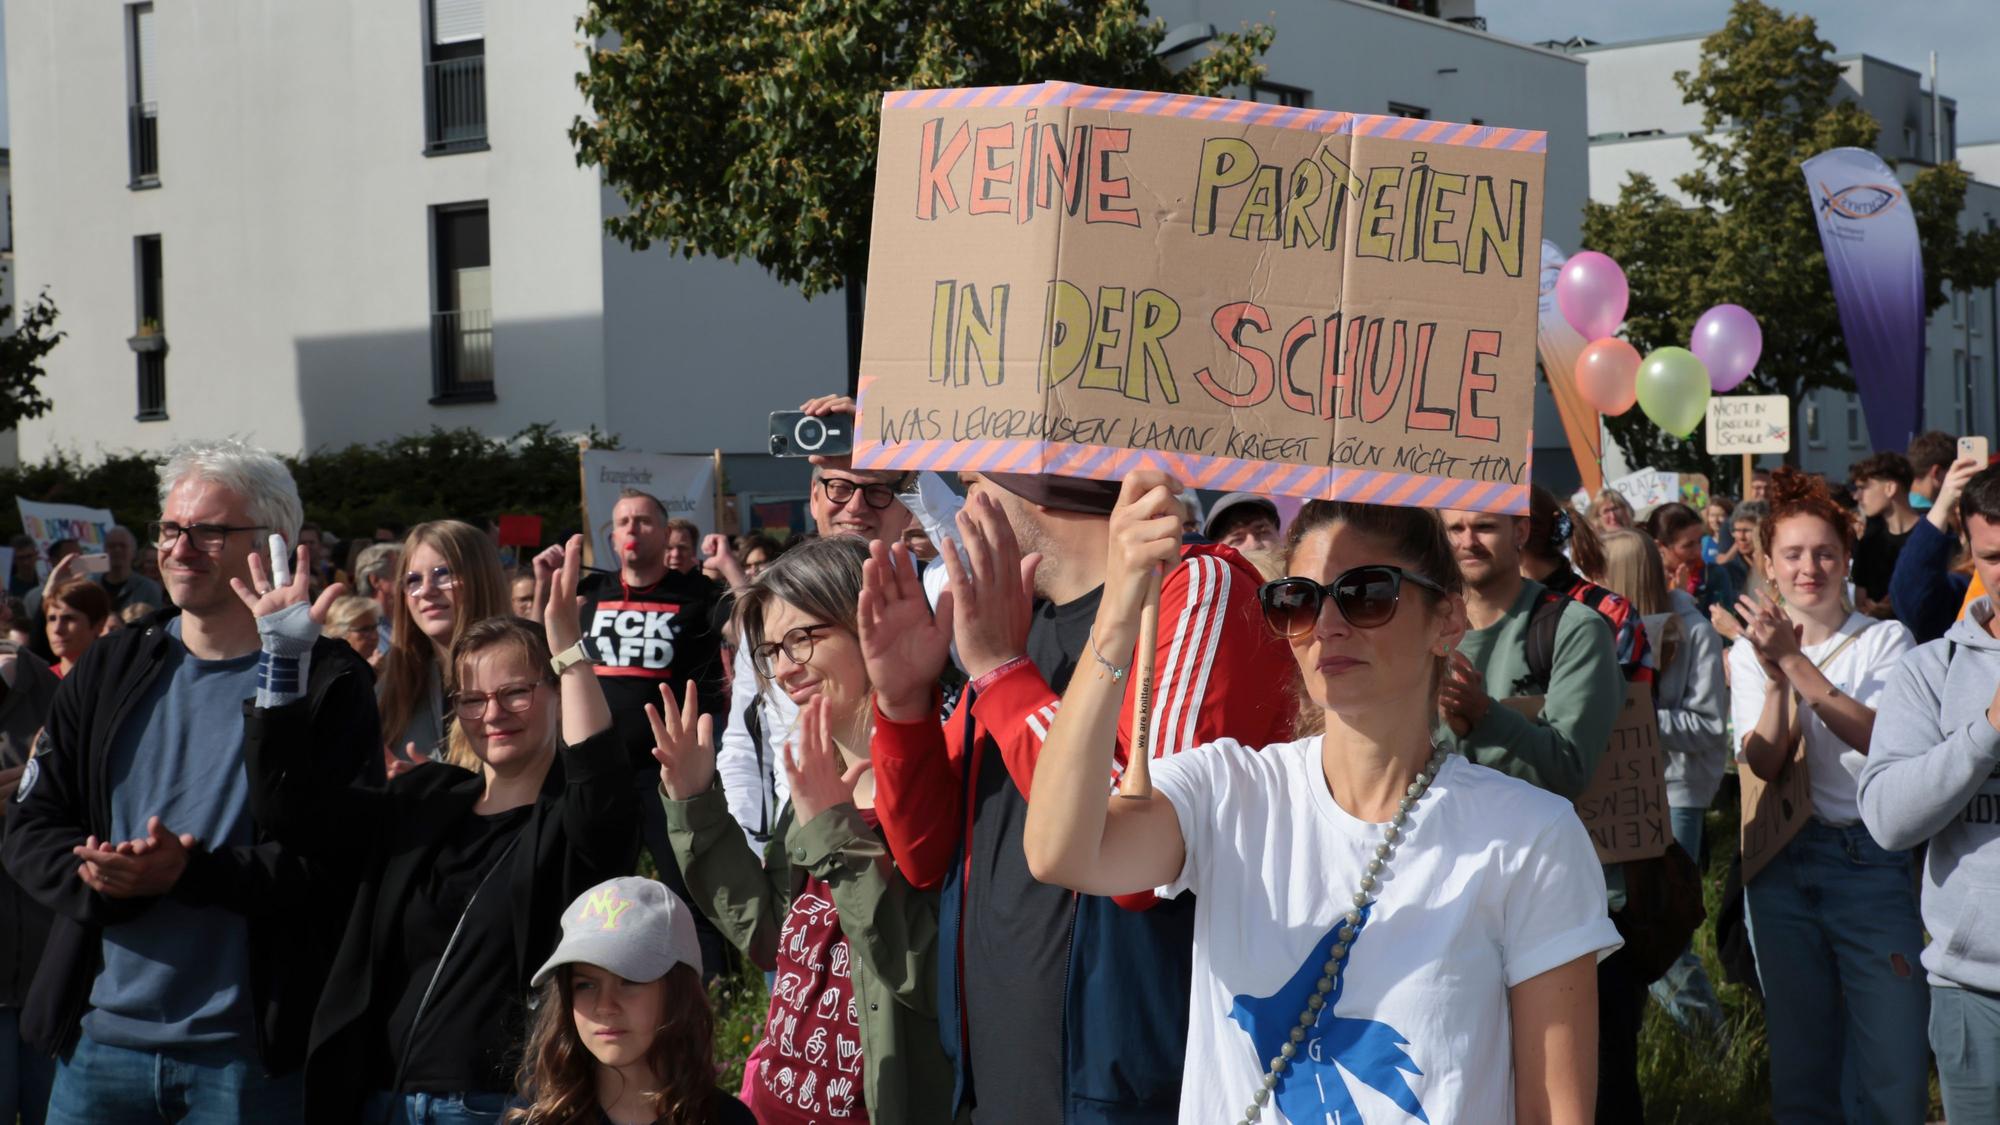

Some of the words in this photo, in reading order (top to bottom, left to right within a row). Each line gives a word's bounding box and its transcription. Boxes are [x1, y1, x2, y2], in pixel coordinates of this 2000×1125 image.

[916, 108, 1142, 229] KEINE
[1192, 137, 1528, 277] PARTEIEN
[929, 279, 1010, 388] IN
[1036, 280, 1181, 404] DER
[1193, 301, 1502, 442] SCHULE
[881, 405, 943, 446] WAS
[953, 405, 1121, 444] LEVERKUSEN
[1224, 425, 1319, 462] KRIEGT
[1327, 435, 1385, 467] KÖLN
[1393, 443, 1467, 479] NICHT
[1470, 455, 1528, 485] HIN
[590, 610, 676, 640] FCK
[595, 636, 674, 669] AFD
[1140, 677, 1151, 714] knitters
[1138, 734, 1146, 749] we
[1139, 717, 1147, 733] are
[1609, 756, 1658, 781] IST
[1581, 784, 1662, 821] MENS
[1589, 818, 1665, 849] KEIN
[577, 888, 634, 929] NY
